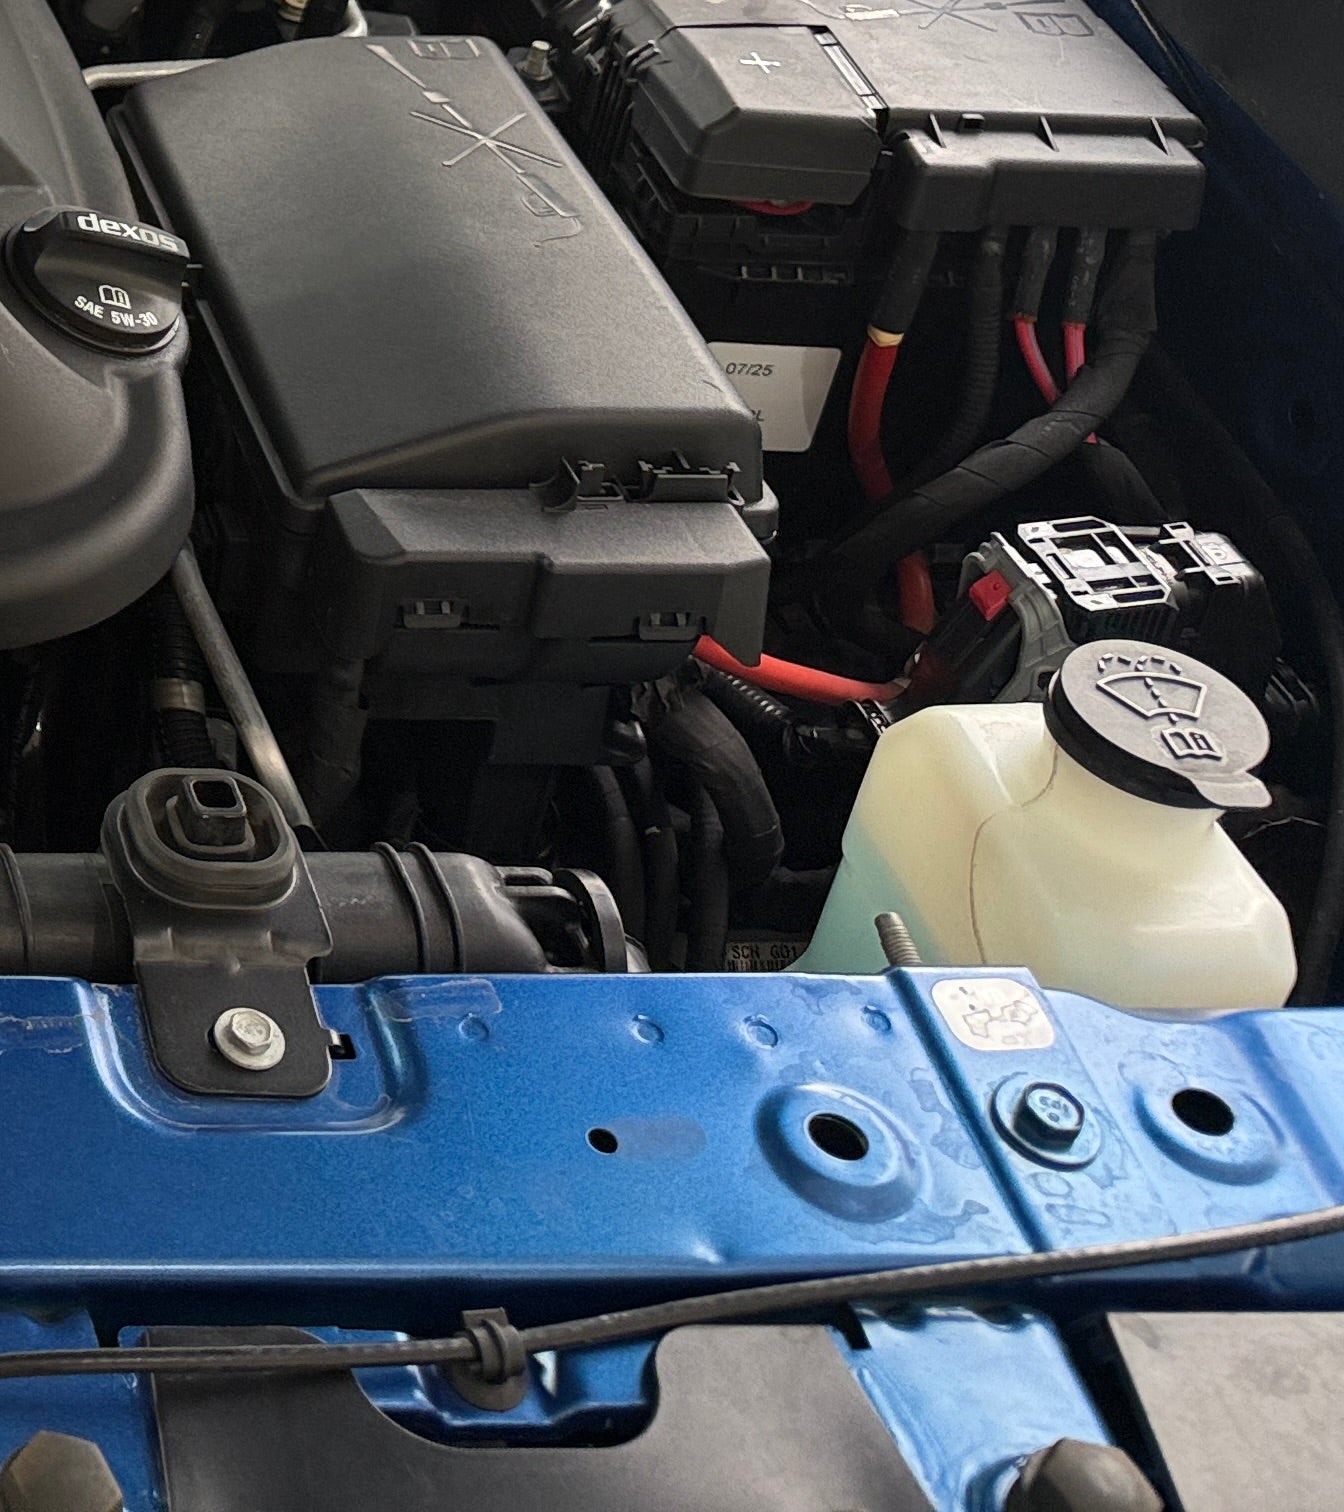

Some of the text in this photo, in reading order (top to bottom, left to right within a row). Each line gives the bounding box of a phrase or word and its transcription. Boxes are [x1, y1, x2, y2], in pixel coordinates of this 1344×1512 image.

[76, 212, 180, 254] dexos
[74, 295, 158, 328] SAE 5W-30
[725, 362, 775, 377] 07/25
